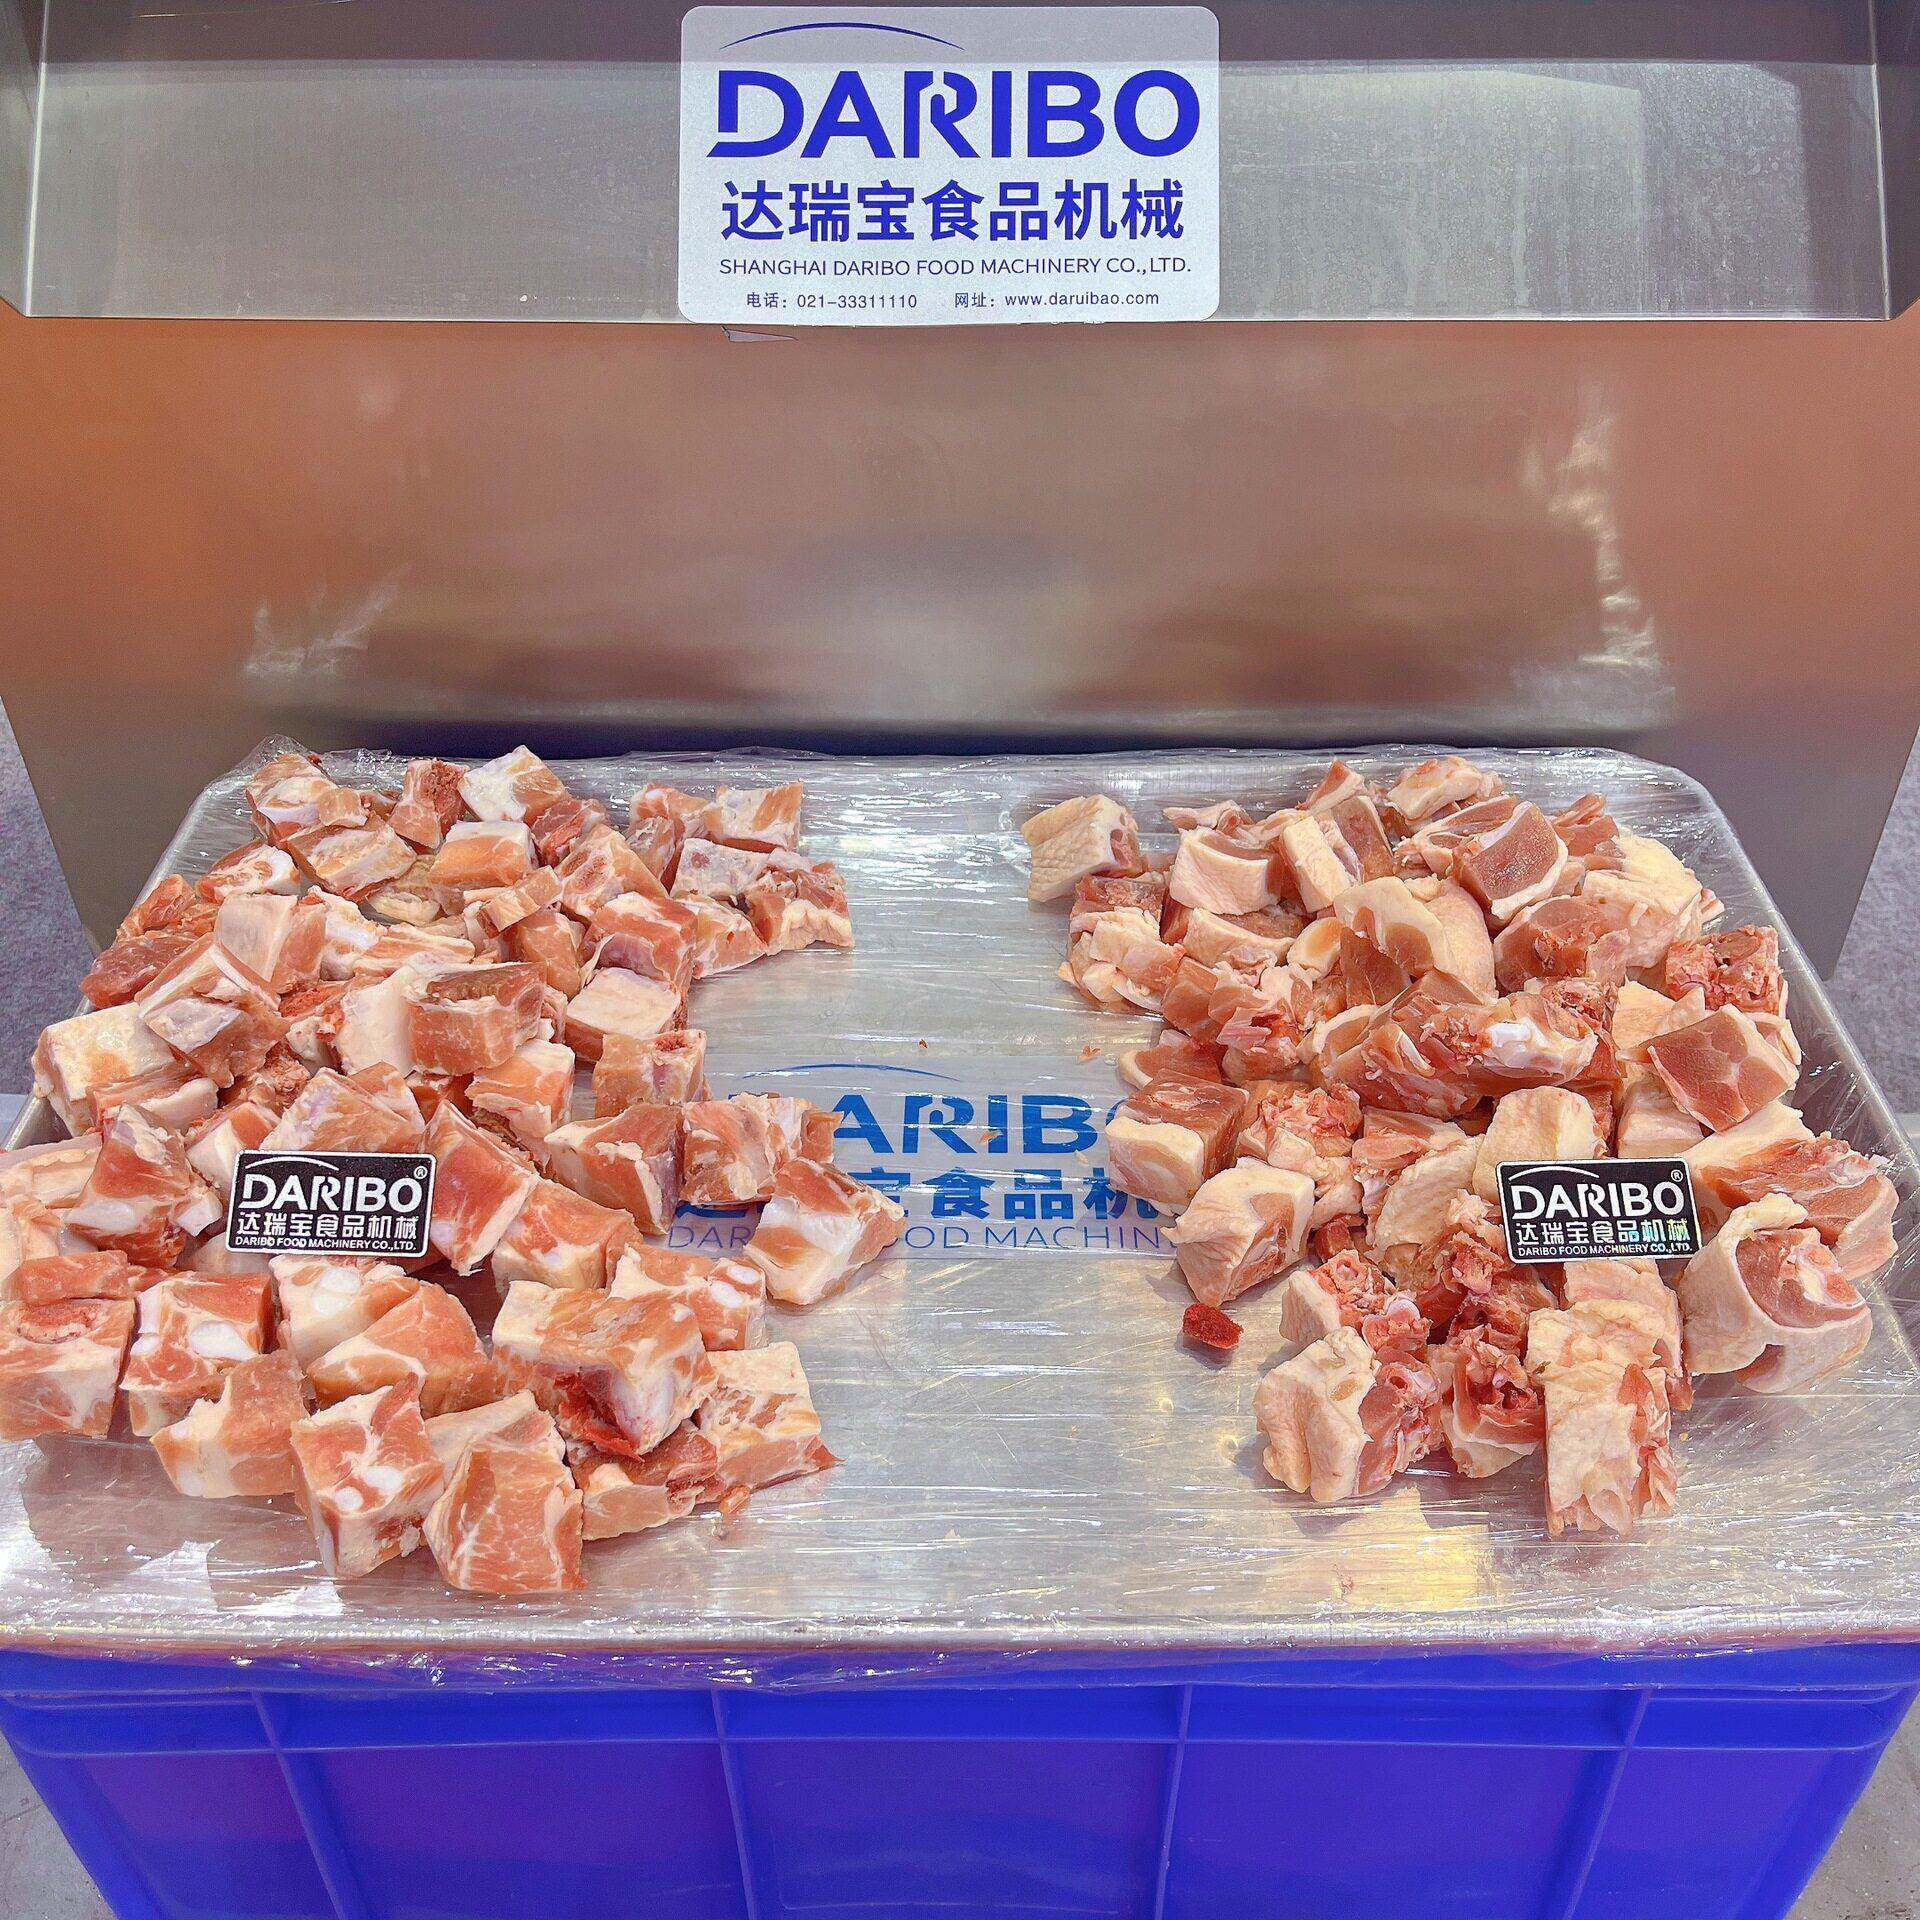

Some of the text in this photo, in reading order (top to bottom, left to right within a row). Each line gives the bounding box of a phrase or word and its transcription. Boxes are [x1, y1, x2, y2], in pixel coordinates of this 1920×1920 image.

[706, 69, 1201, 159] DARIBO
[719, 177, 1185, 242] 达瑞宝食品机械
[719, 258, 826, 276] SHANGHAI
[833, 259, 910, 276] DARIBO
[916, 258, 975, 276] FOOD
[980, 257, 1101, 275] MACHINERY
[796, 293, 918, 309] 021-33311110
[1004, 291, 1160, 307] www.daruibao.com
[727, 1093, 1131, 1155] ARIB
[237, 1211, 419, 1240] 达瑞宝食品机械
[668, 1225, 752, 1249] DAR
[984, 1225, 1177, 1249] MACHIN
[1515, 1217, 1691, 1246] 达瑞宝食品机械
[235, 1236, 275, 1247] DARIBO
[276, 1237, 306, 1248] FOOD
[308, 1238, 371, 1249] MACHINERY
[1518, 1246, 1557, 1257] DARIBO
[1558, 1245, 1588, 1256] FOOD
[1589, 1243, 1649, 1255] MACHINERY
